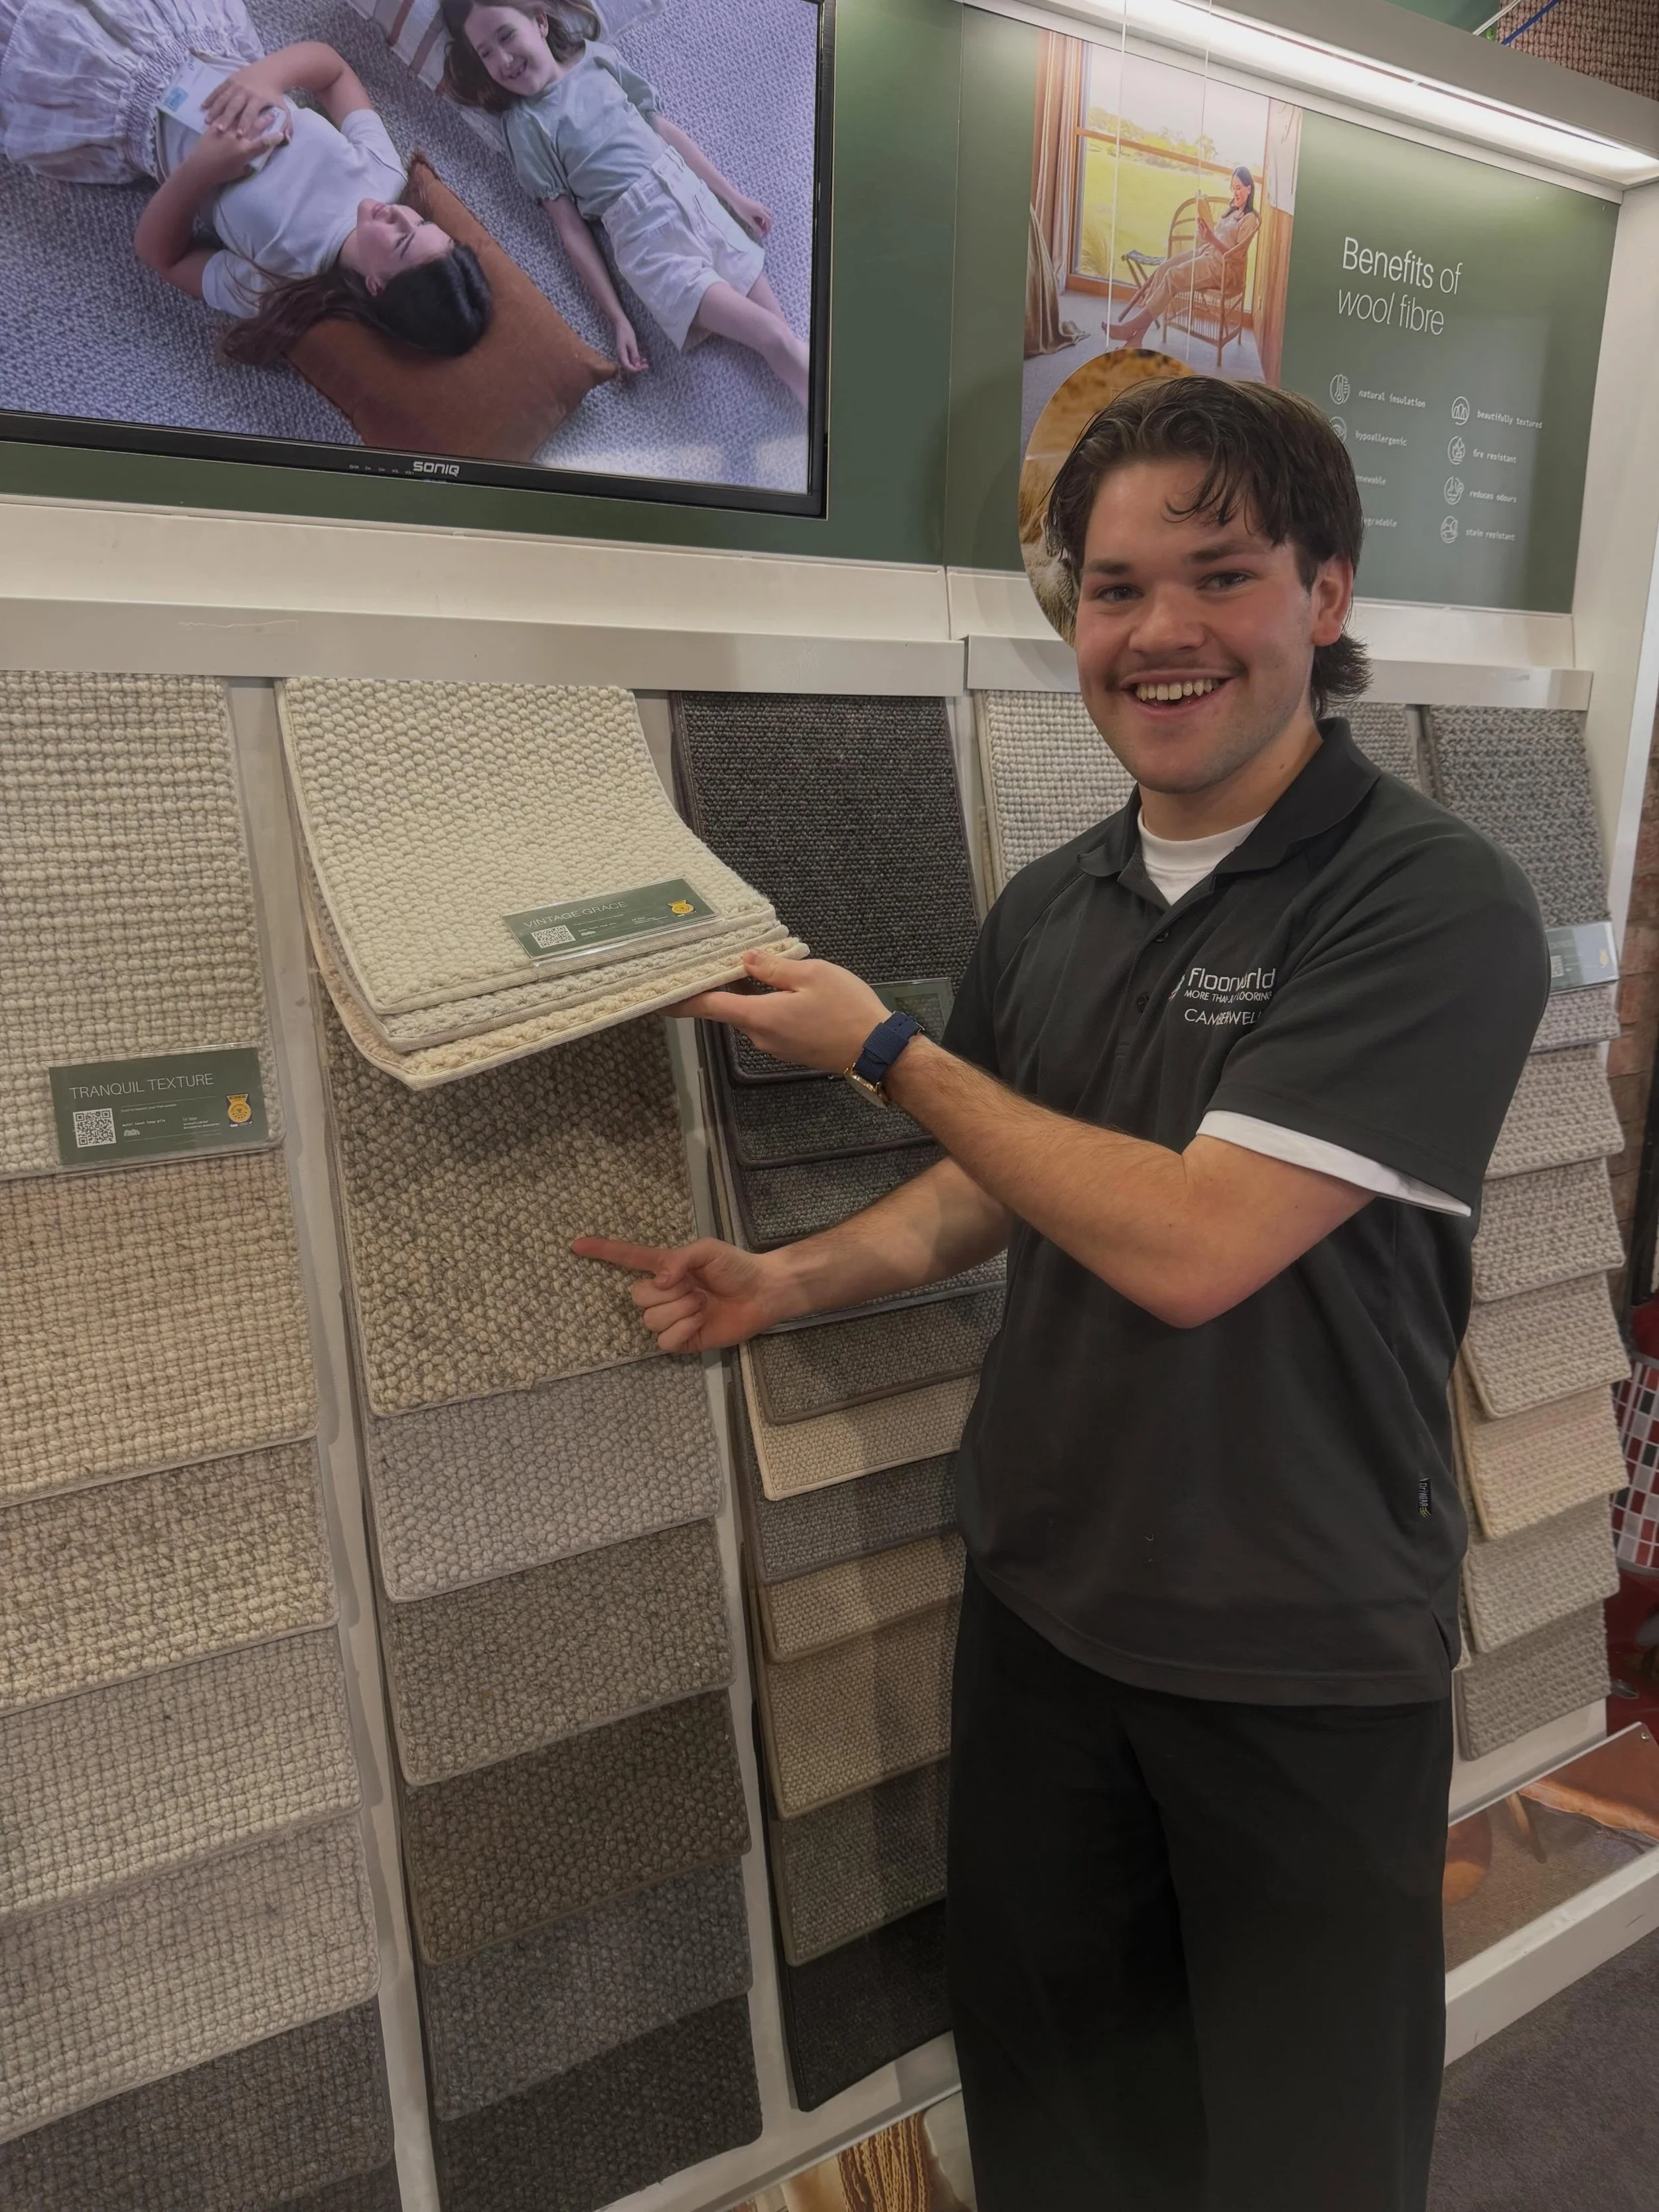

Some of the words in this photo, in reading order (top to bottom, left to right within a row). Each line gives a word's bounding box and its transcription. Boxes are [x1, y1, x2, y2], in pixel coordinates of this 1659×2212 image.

[1342, 236, 1433, 289] Benefits
[1440, 263, 1463, 295] of
[1338, 289, 1395, 325] wool
[1400, 294, 1444, 335] fibre
[1358, 390, 1385, 401] natural
[1390, 394, 1425, 407] insulation
[1477, 409, 1513, 425] beautifully
[1516, 417, 1543, 428] textured
[1355, 430, 1407, 446] hypoallergenic
[1473, 449, 1484, 459] fire
[1487, 453, 1517, 463] resistant
[413, 461, 459, 477] SONIQ
[1469, 490, 1493, 500] reduces
[1496, 493, 1516, 503] odours
[1465, 529, 1482, 538] stain
[1485, 531, 1516, 541] resistant
[523, 911, 581, 927] VINTAGE
[582, 901, 628, 915] GRACE
[1185, 990, 1210, 1001] MORE
[69, 1082, 145, 1099] TRANQUIL
[146, 1073, 214, 1090] TEXTURE
